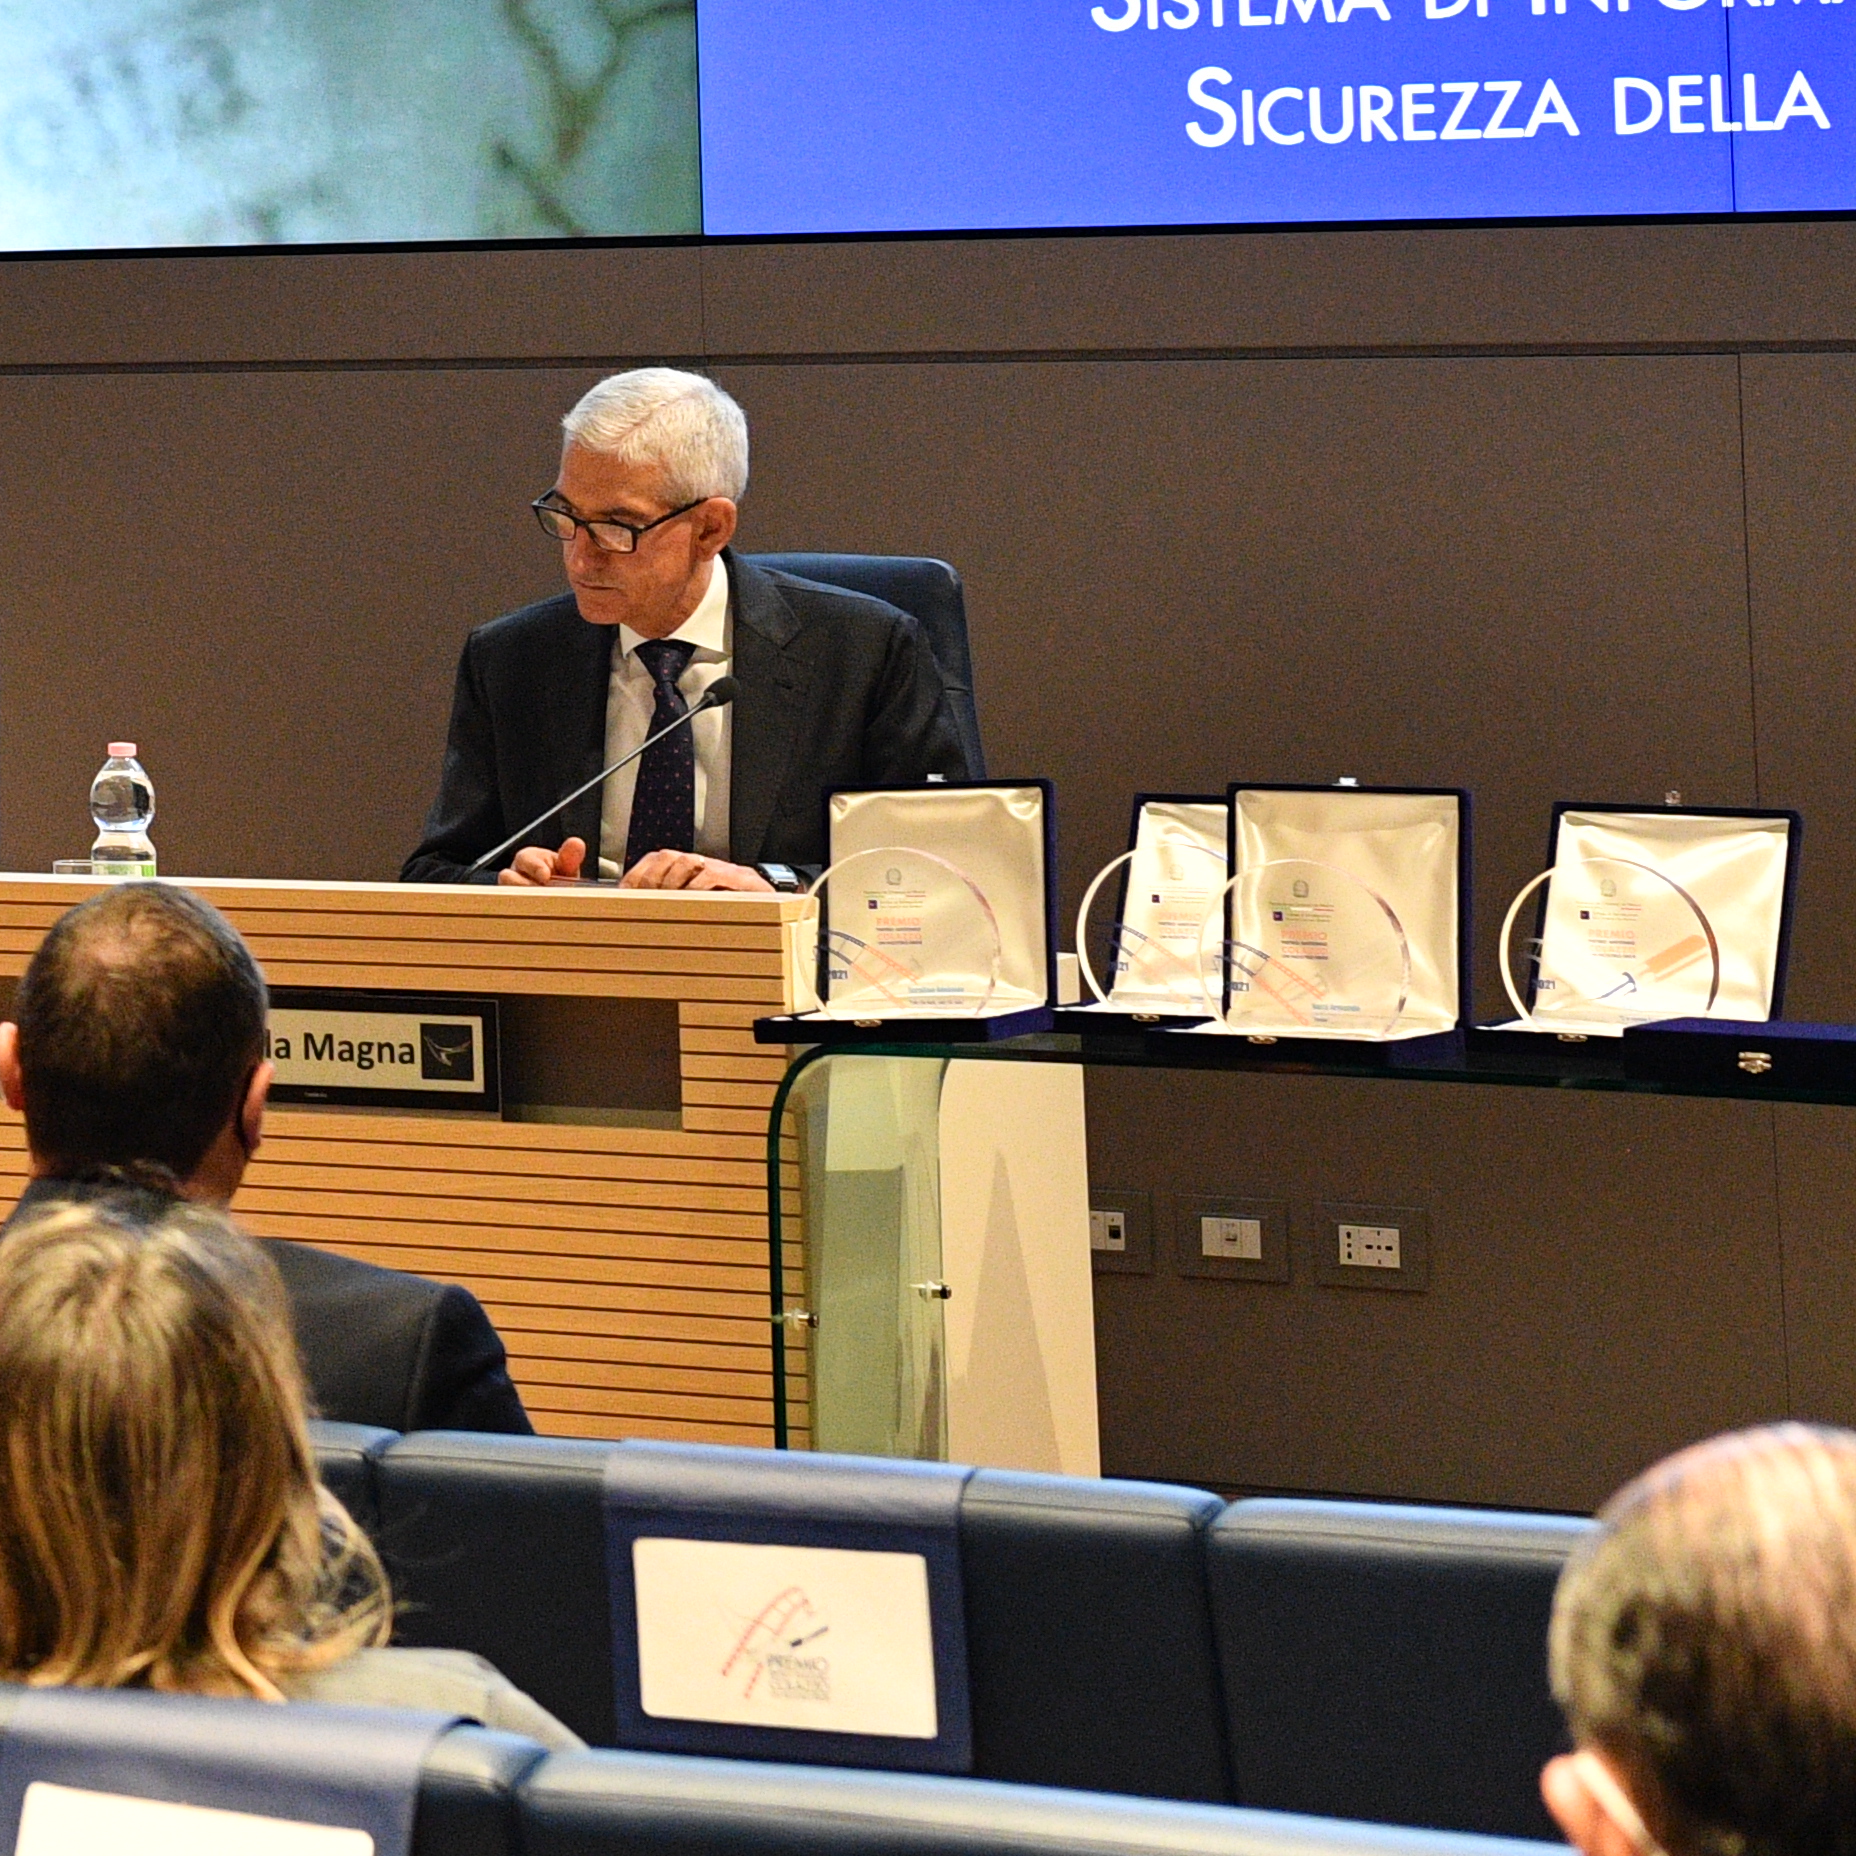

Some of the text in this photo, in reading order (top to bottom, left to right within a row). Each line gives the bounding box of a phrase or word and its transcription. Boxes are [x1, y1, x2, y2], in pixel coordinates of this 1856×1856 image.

[1184, 65, 1832, 149] SICUREZZA DELLA
[303, 1031, 416, 1071] Magna
